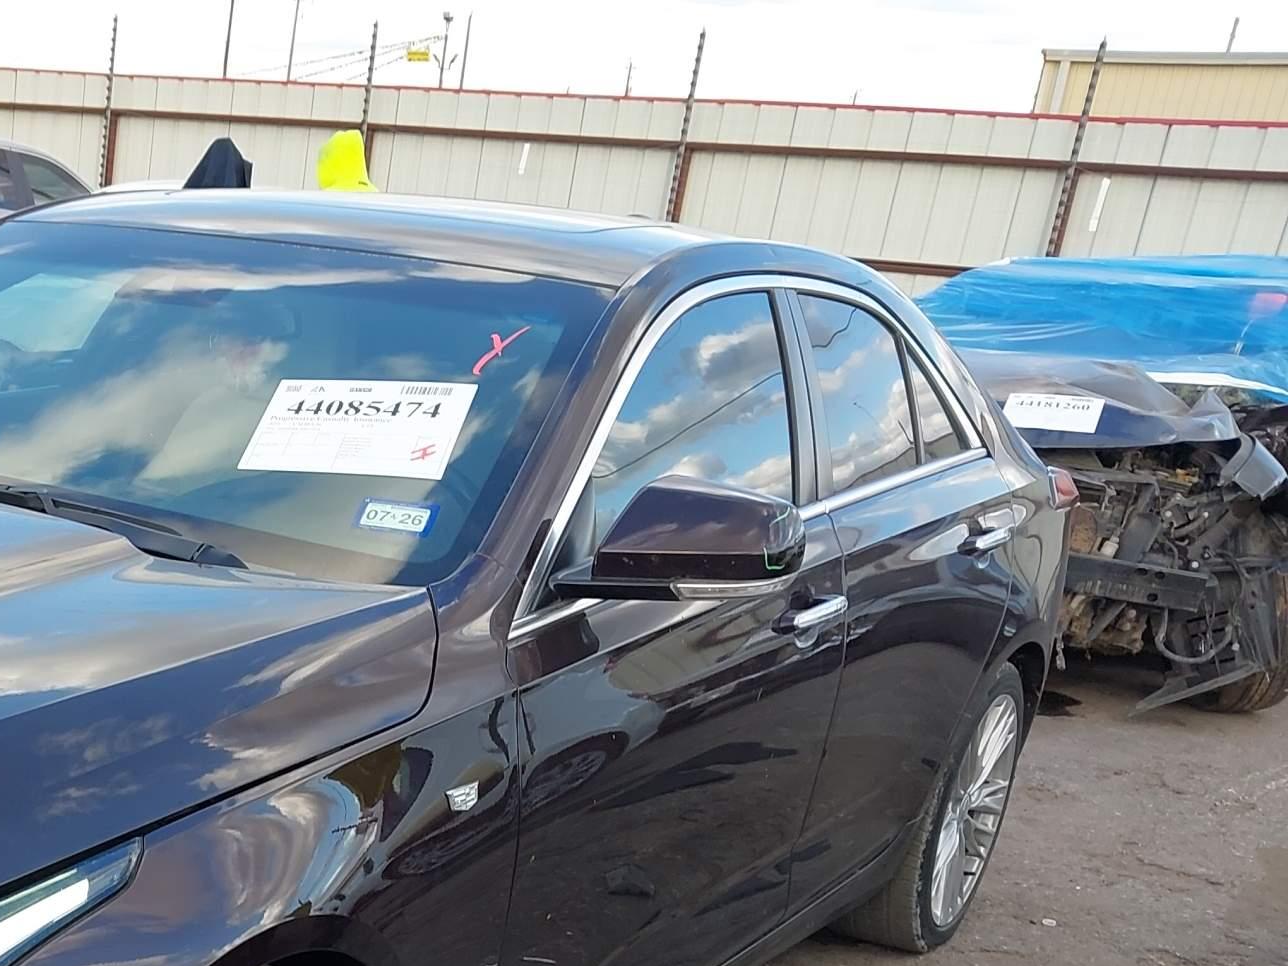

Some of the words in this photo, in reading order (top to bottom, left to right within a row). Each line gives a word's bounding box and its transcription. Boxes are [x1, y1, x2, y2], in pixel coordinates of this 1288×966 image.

[287, 399, 442, 418] 44085474
[366, 508, 392, 522] 07
[398, 513, 424, 526] 26
